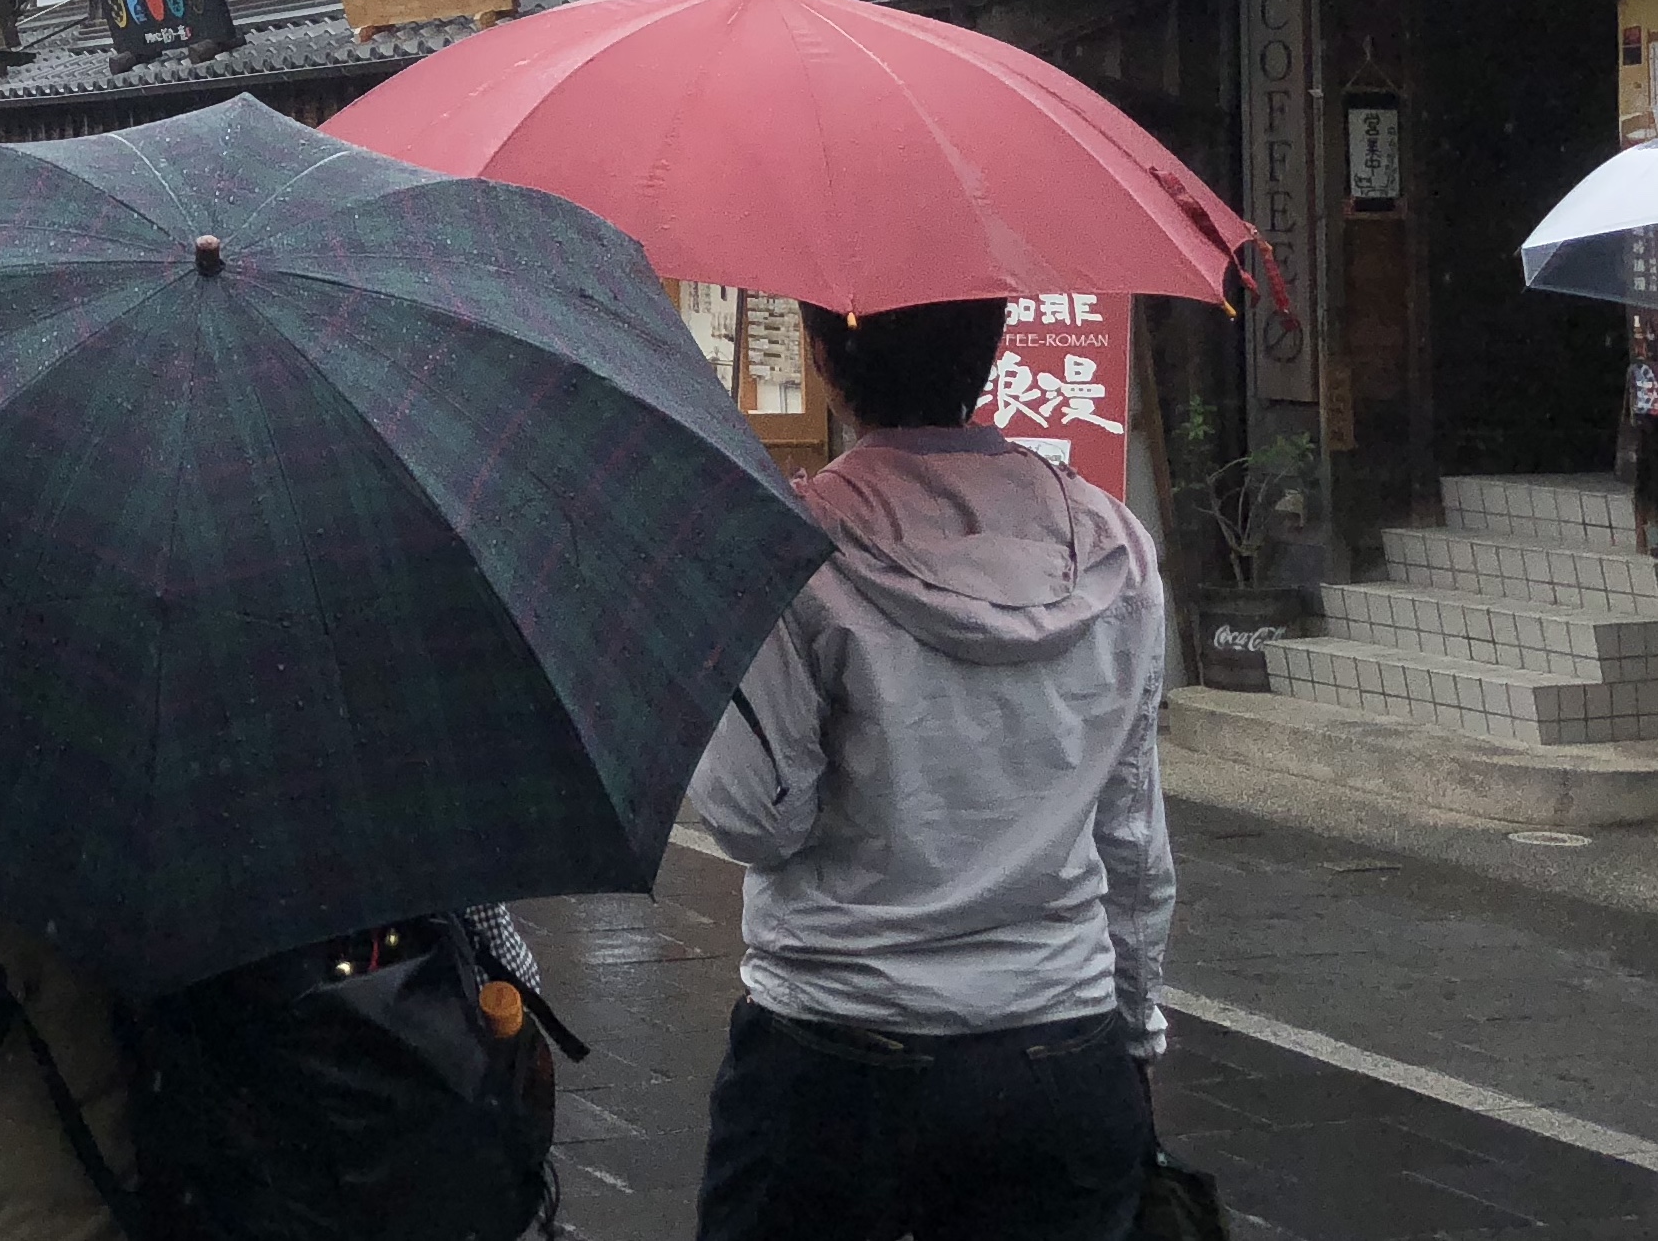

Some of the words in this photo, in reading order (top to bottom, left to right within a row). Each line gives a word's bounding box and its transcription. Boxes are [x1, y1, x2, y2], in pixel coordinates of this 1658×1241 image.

[1002, 334, 1109, 347] FEE-ROMAN
[976, 351, 1124, 435] 浪漫
[1213, 624, 1286, 651] Coca-C
